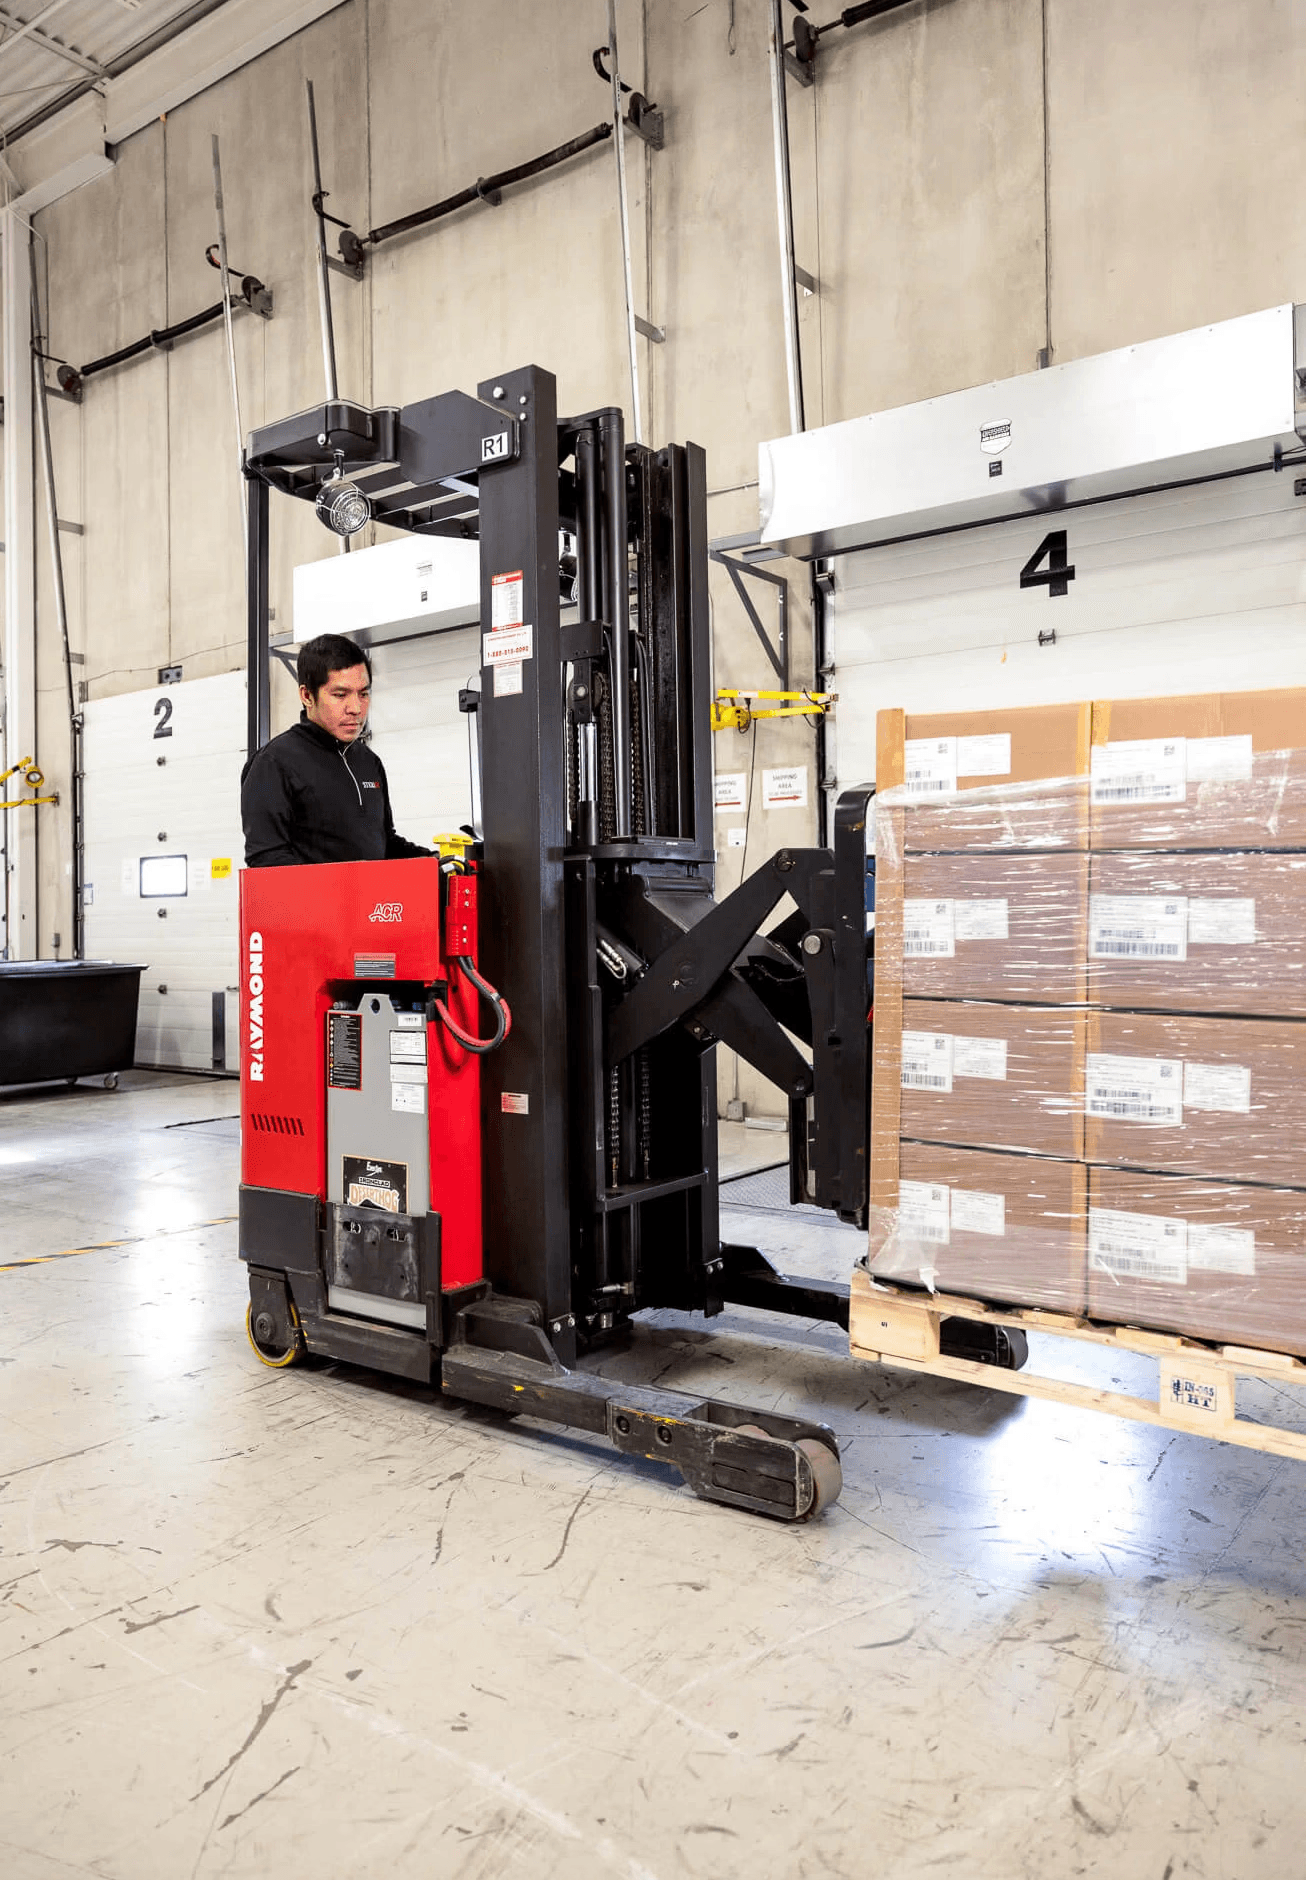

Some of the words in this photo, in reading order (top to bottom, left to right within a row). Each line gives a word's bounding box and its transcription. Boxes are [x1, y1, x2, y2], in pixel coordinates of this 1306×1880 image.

[484, 435, 503, 457] R1
[1020, 530, 1075, 597] 4
[153, 697, 173, 739] 2
[773, 773, 797, 781] SHIPPING
[368, 903, 403, 922] ACR
[249, 931, 264, 1082] RAYMOND
[359, 1177, 391, 1187] IRONCLAD
